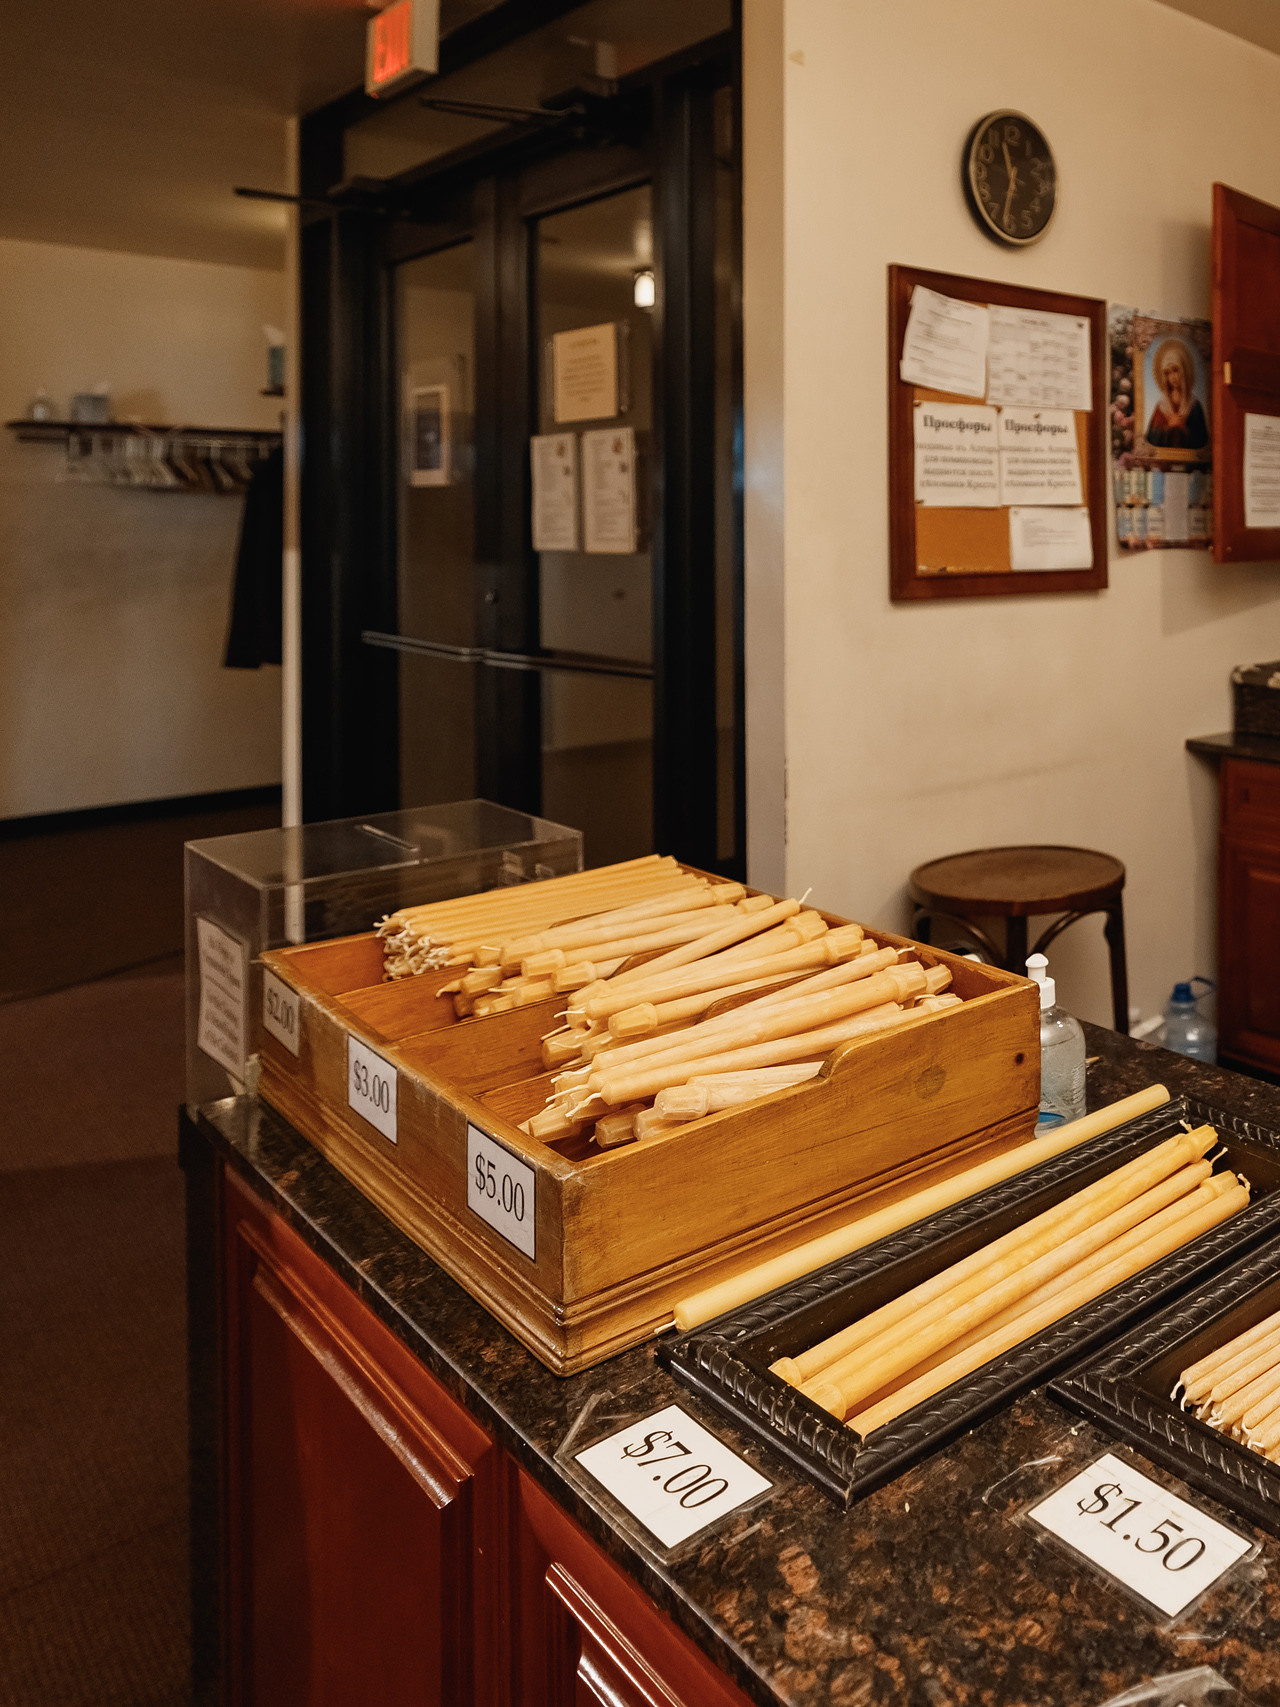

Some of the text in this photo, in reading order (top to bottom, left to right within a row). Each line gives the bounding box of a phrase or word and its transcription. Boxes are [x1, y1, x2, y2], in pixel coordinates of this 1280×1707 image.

[1021, 209, 1034, 230] 5
[923, 415, 992, 433] Просфоры
[1004, 419, 1069, 436] Просфоры
[266, 986, 295, 1035] $2.00
[353, 1060, 390, 1115] $3.00
[475, 1152, 525, 1223] $5.00
[622, 1430, 730, 1510] $7.00
[1076, 1482, 1207, 1573] $1.50
